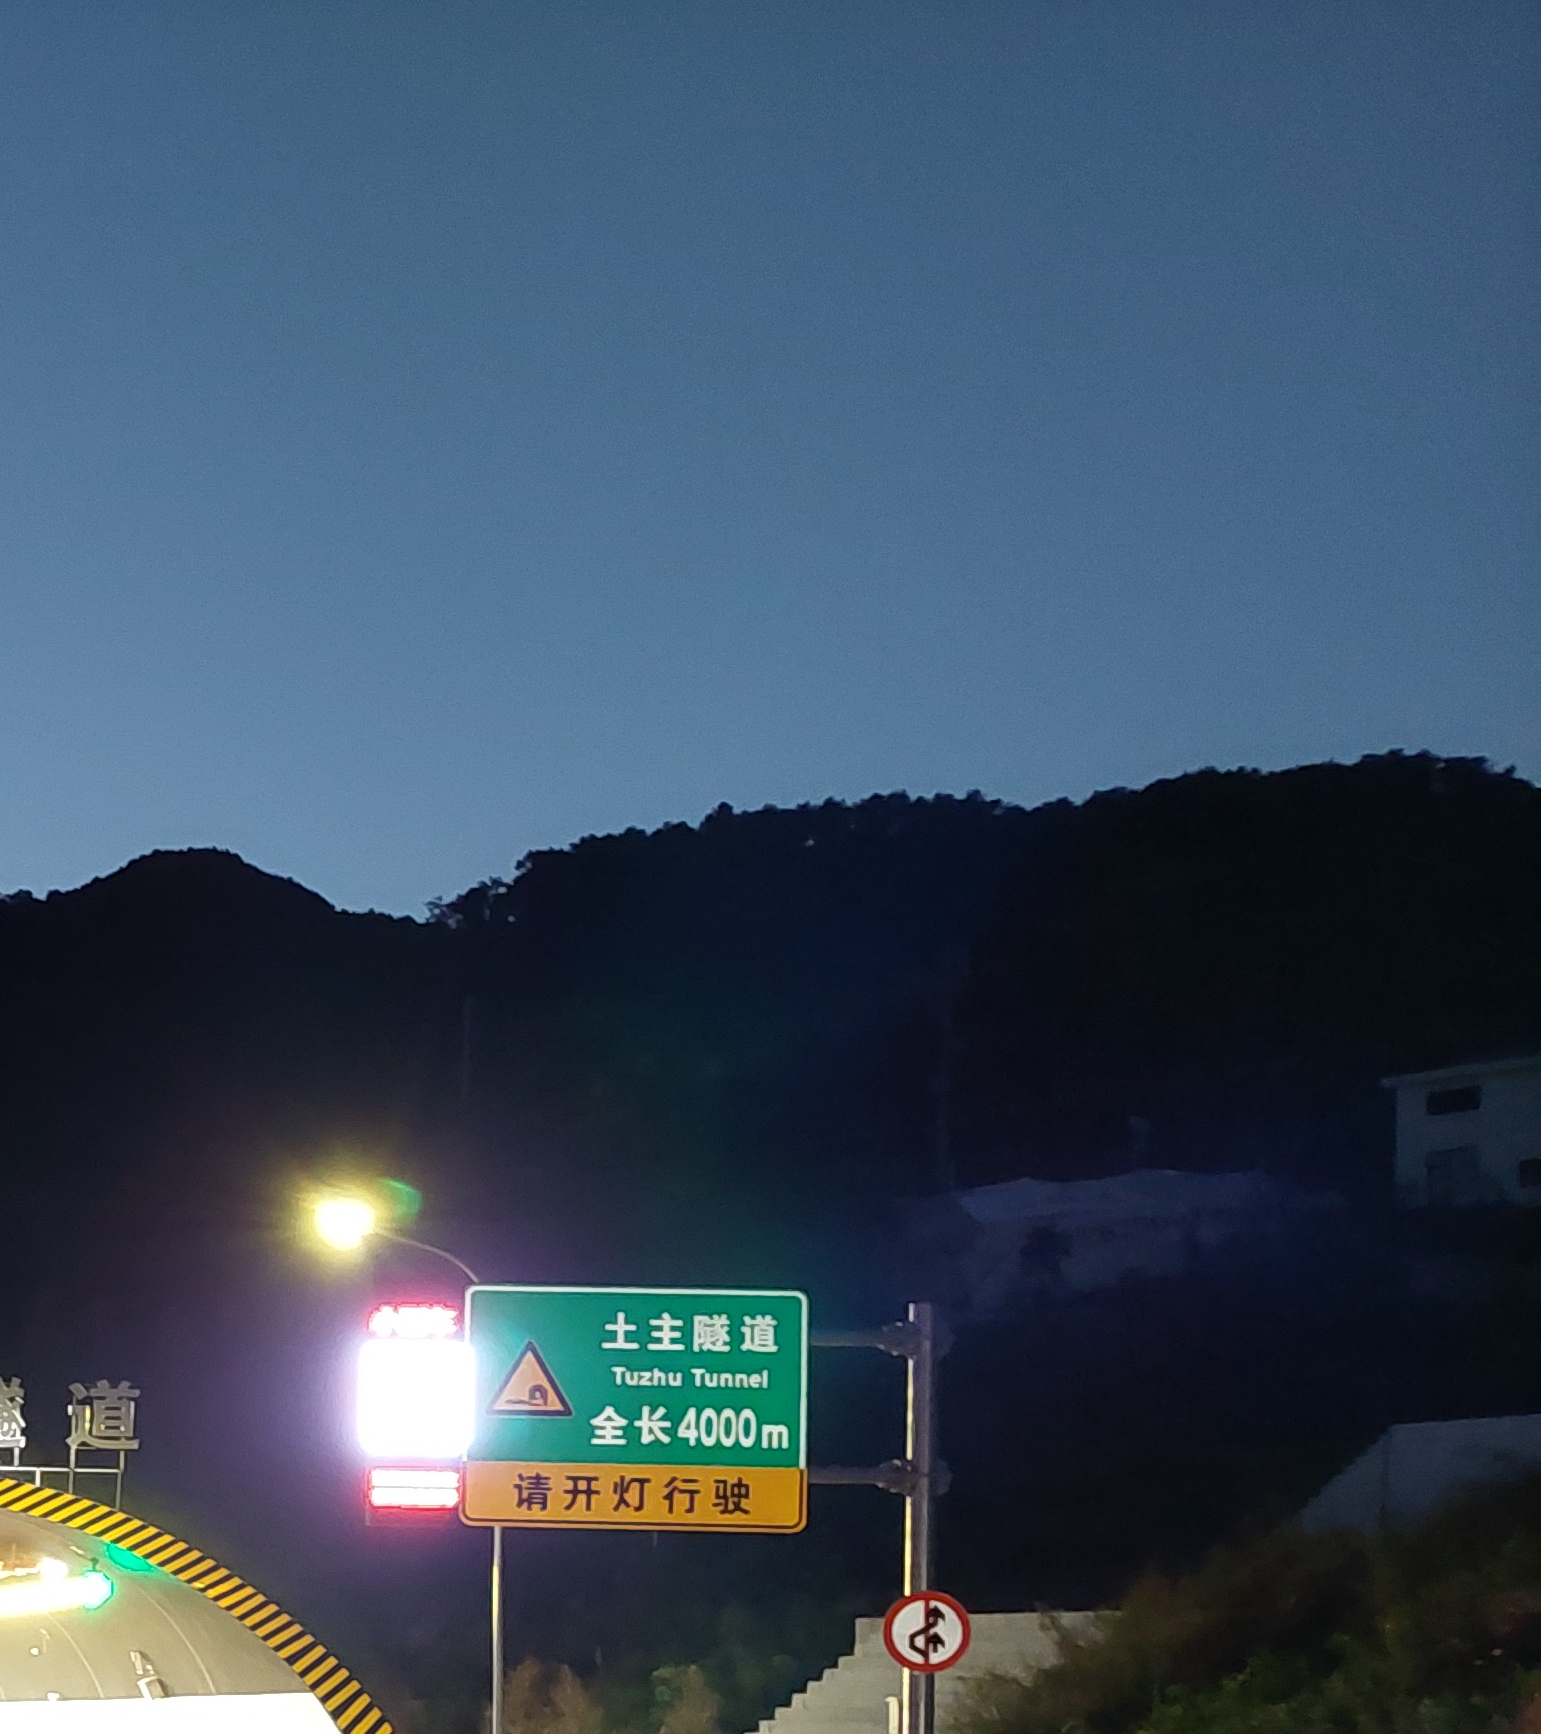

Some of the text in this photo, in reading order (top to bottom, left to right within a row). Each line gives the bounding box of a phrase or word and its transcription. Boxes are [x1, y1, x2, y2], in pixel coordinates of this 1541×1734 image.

[601, 1312, 779, 1352] 土主隧道
[611, 1366, 768, 1388] Tuzhu Tunnel
[513, 1472, 752, 1515] 请开灯行驶
